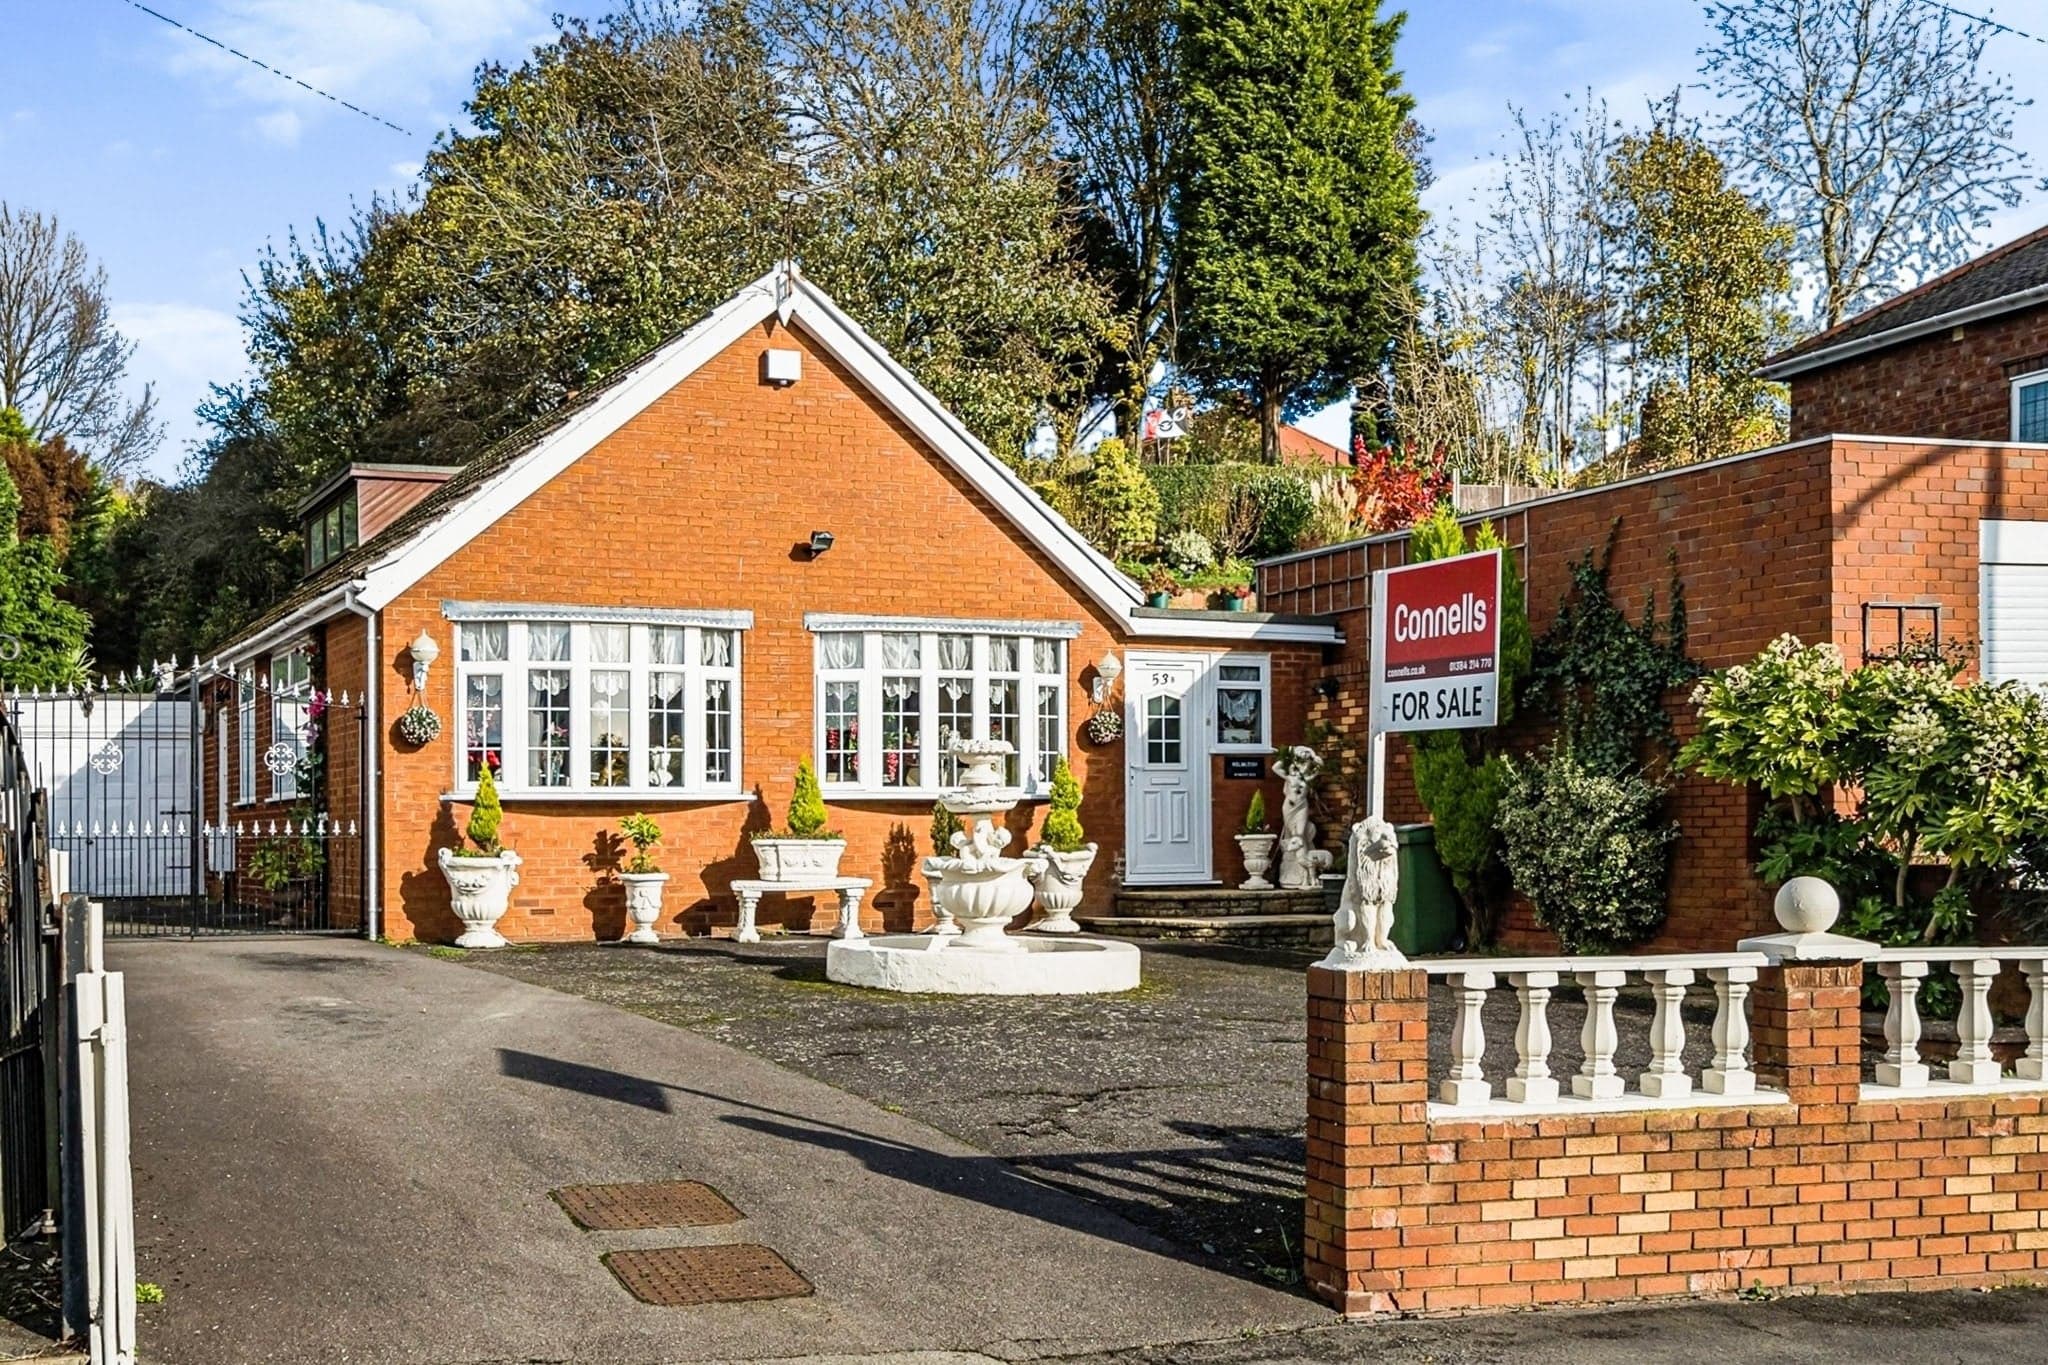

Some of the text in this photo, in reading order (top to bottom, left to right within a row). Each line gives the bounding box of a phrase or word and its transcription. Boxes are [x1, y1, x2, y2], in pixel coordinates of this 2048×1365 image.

[1395, 593, 1487, 642] Connells
[1387, 665, 1426, 677] connells.co.uk
[1481, 658, 1492, 668] 770
[1392, 686, 1483, 722] FOR SALE
